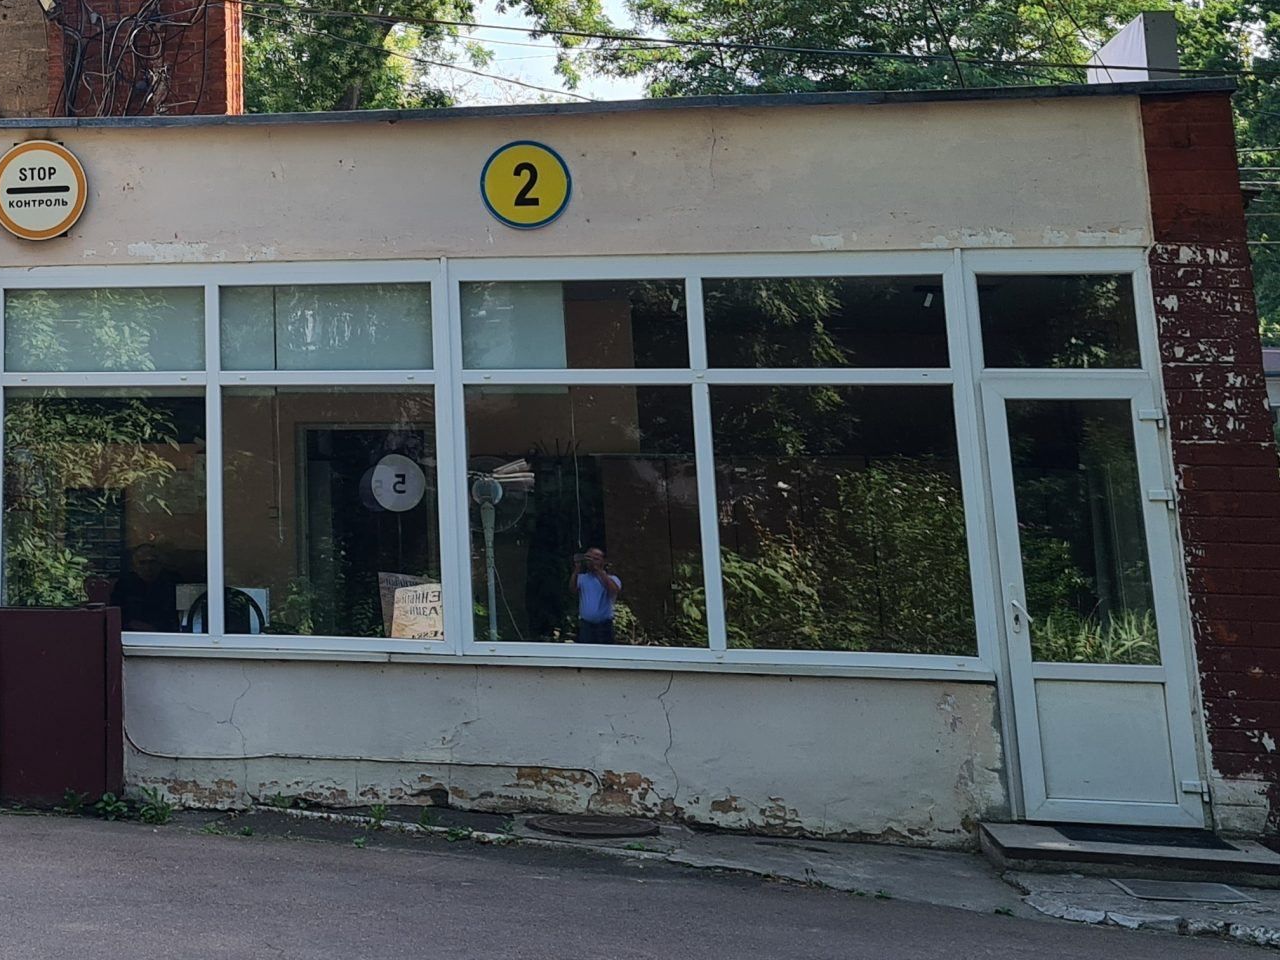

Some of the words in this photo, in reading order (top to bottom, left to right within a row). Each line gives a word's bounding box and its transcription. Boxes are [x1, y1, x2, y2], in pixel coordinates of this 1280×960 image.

[18, 166, 57, 182] STOP
[513, 162, 540, 207] 2
[8, 198, 69, 209] КОНТРОЛЬ
